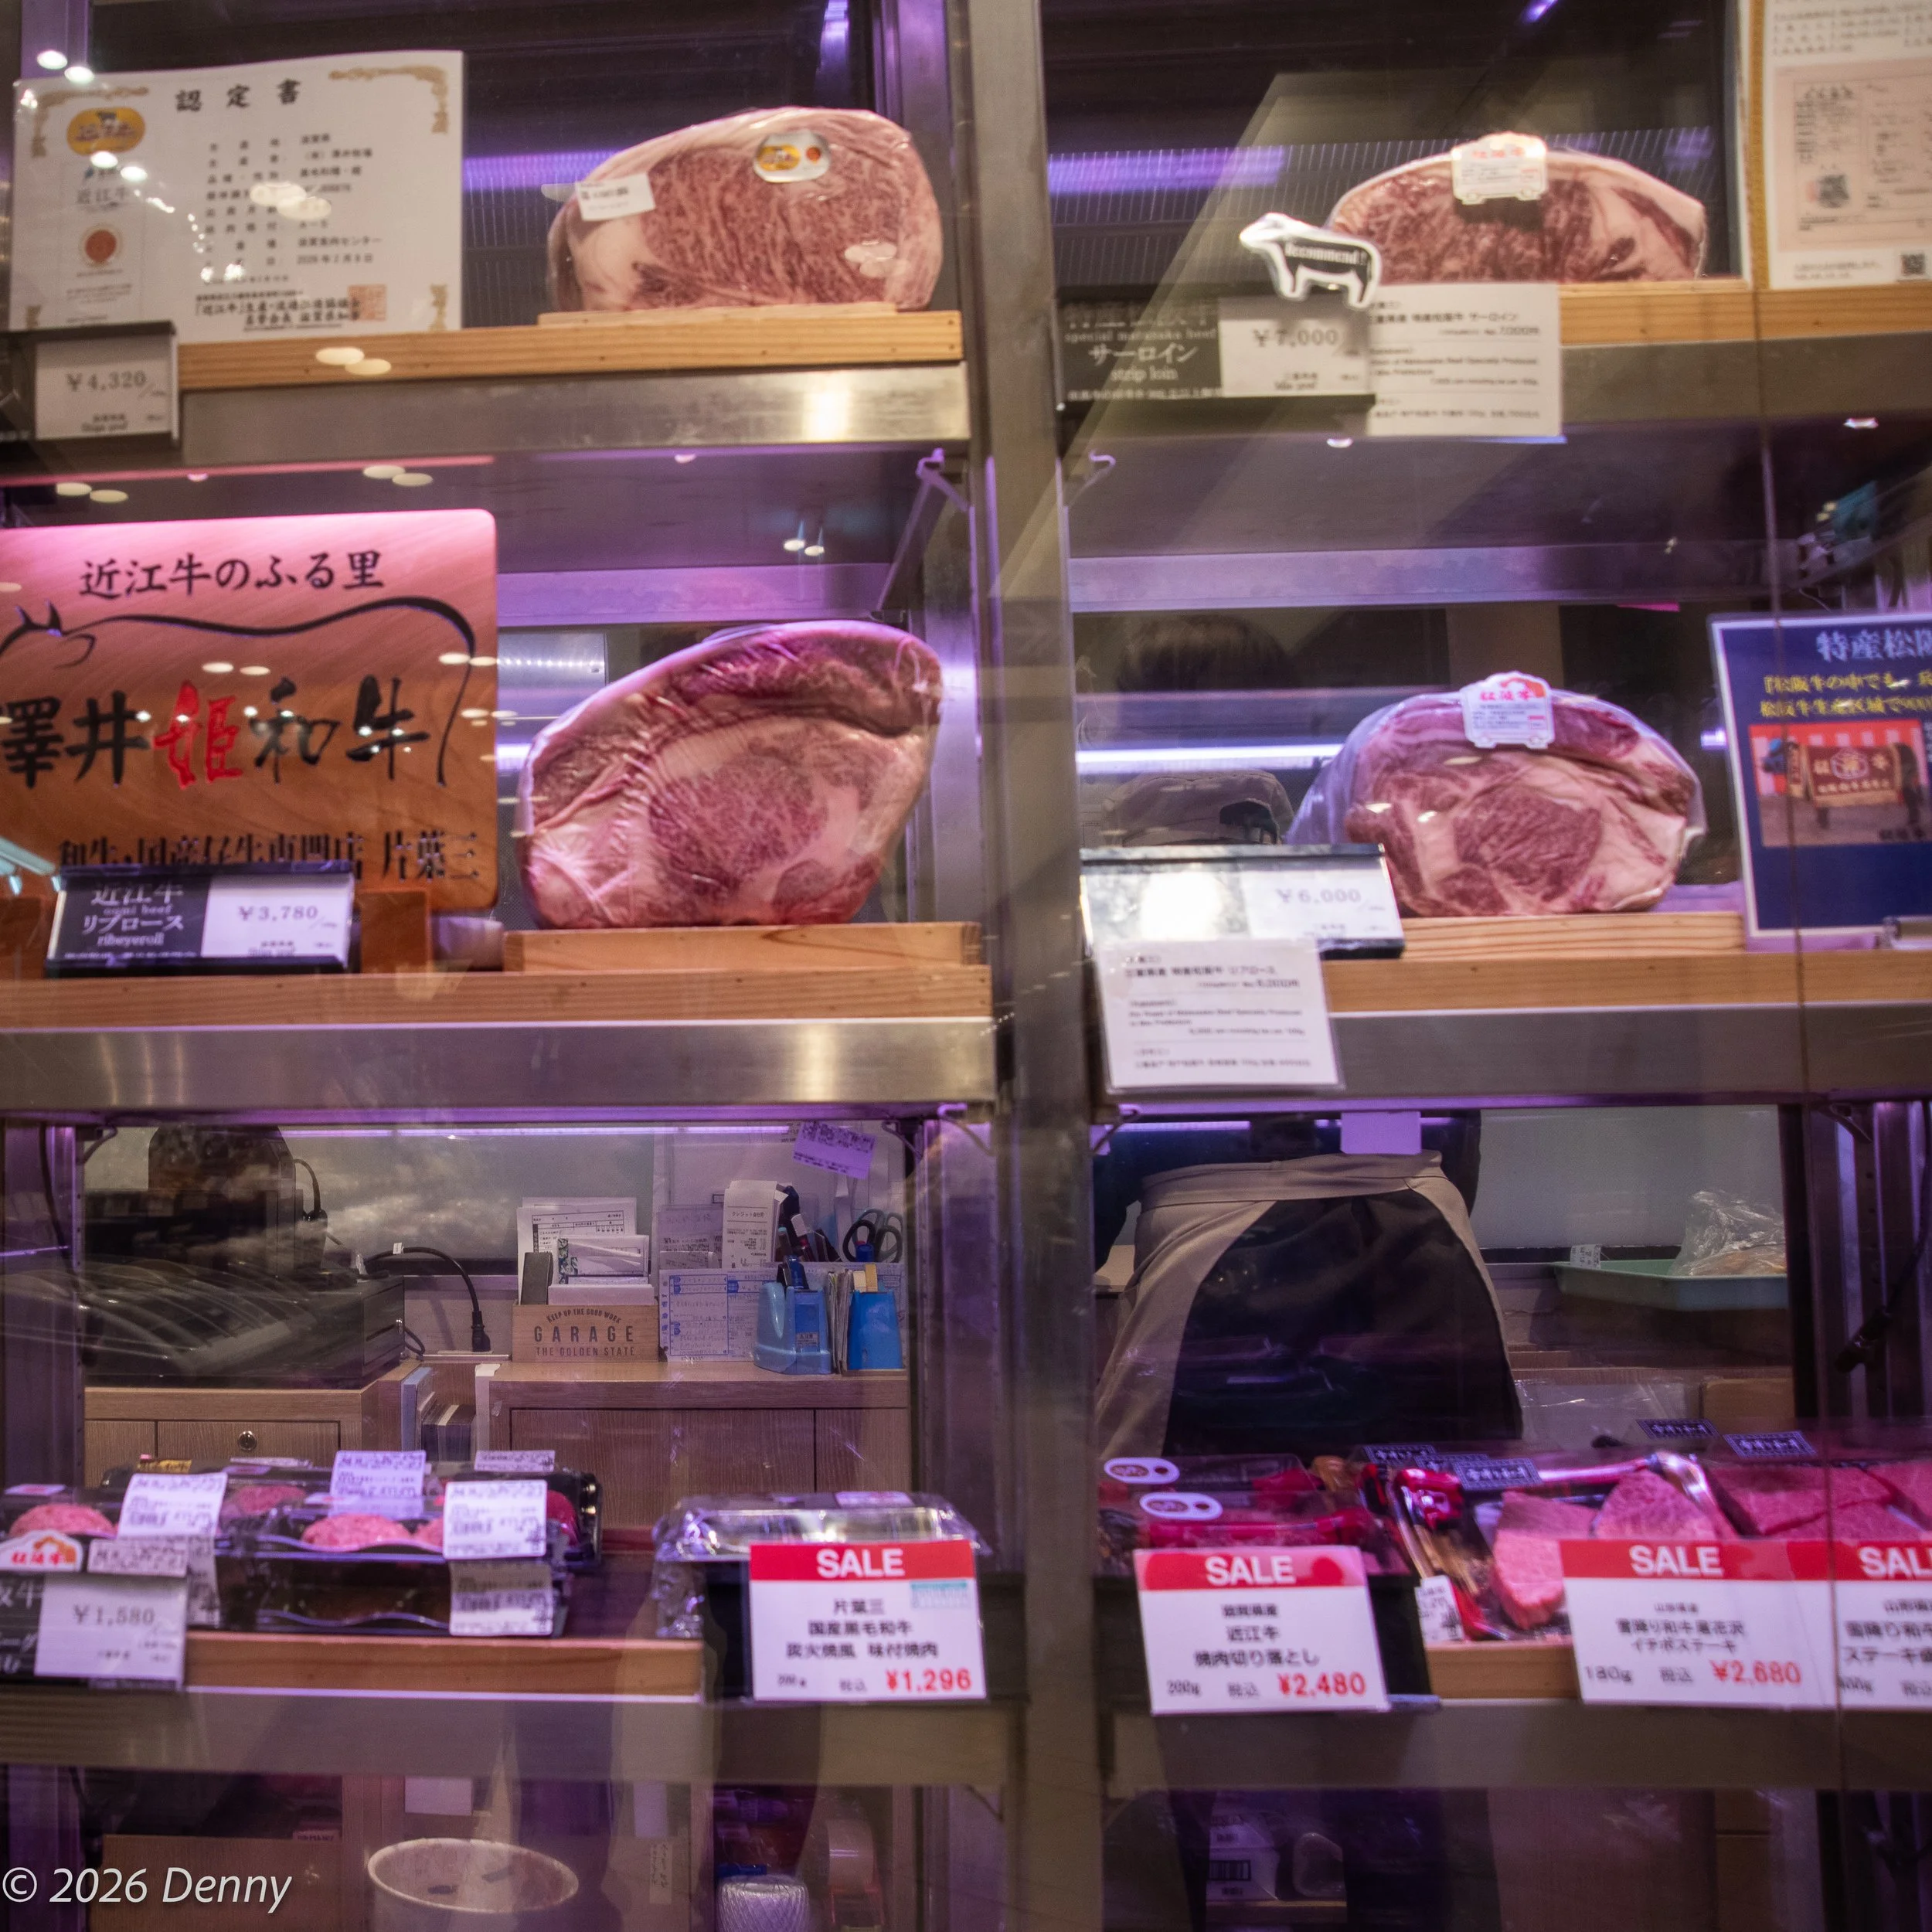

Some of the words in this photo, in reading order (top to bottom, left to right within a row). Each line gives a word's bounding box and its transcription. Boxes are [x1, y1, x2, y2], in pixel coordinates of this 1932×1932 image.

[175, 78, 301, 114] 認定書
[1253, 328, 1339, 348] ¥7,000
[1087, 342, 1199, 366] サーロイン
[66, 369, 148, 393] ¥4,320
[79, 549, 386, 600] 近江牛のふる里
[1275, 887, 1362, 905] ¥6,000
[81, 914, 185, 936] リブロース
[238, 905, 318, 921] ¥3,780
[534, 1325, 634, 1342] GARAGE
[536, 1347, 554, 1355] THE
[604, 1347, 635, 1355] STATE
[817, 1548, 906, 1578] SALE
[1204, 1555, 1297, 1585] SALE
[1629, 1546, 1725, 1576] SALE
[1857, 1546, 1932, 1577] SAL
[73, 1605, 155, 1627] ¥1,580
[1226, 1625, 1281, 1642] 近江牛
[1193, 1648, 1320, 1668] 焼肉切り落とし
[886, 1668, 973, 1692] ¥1,296
[1277, 1671, 1367, 1698] ¥2,480
[1709, 1660, 1804, 1685] ¥2,680
